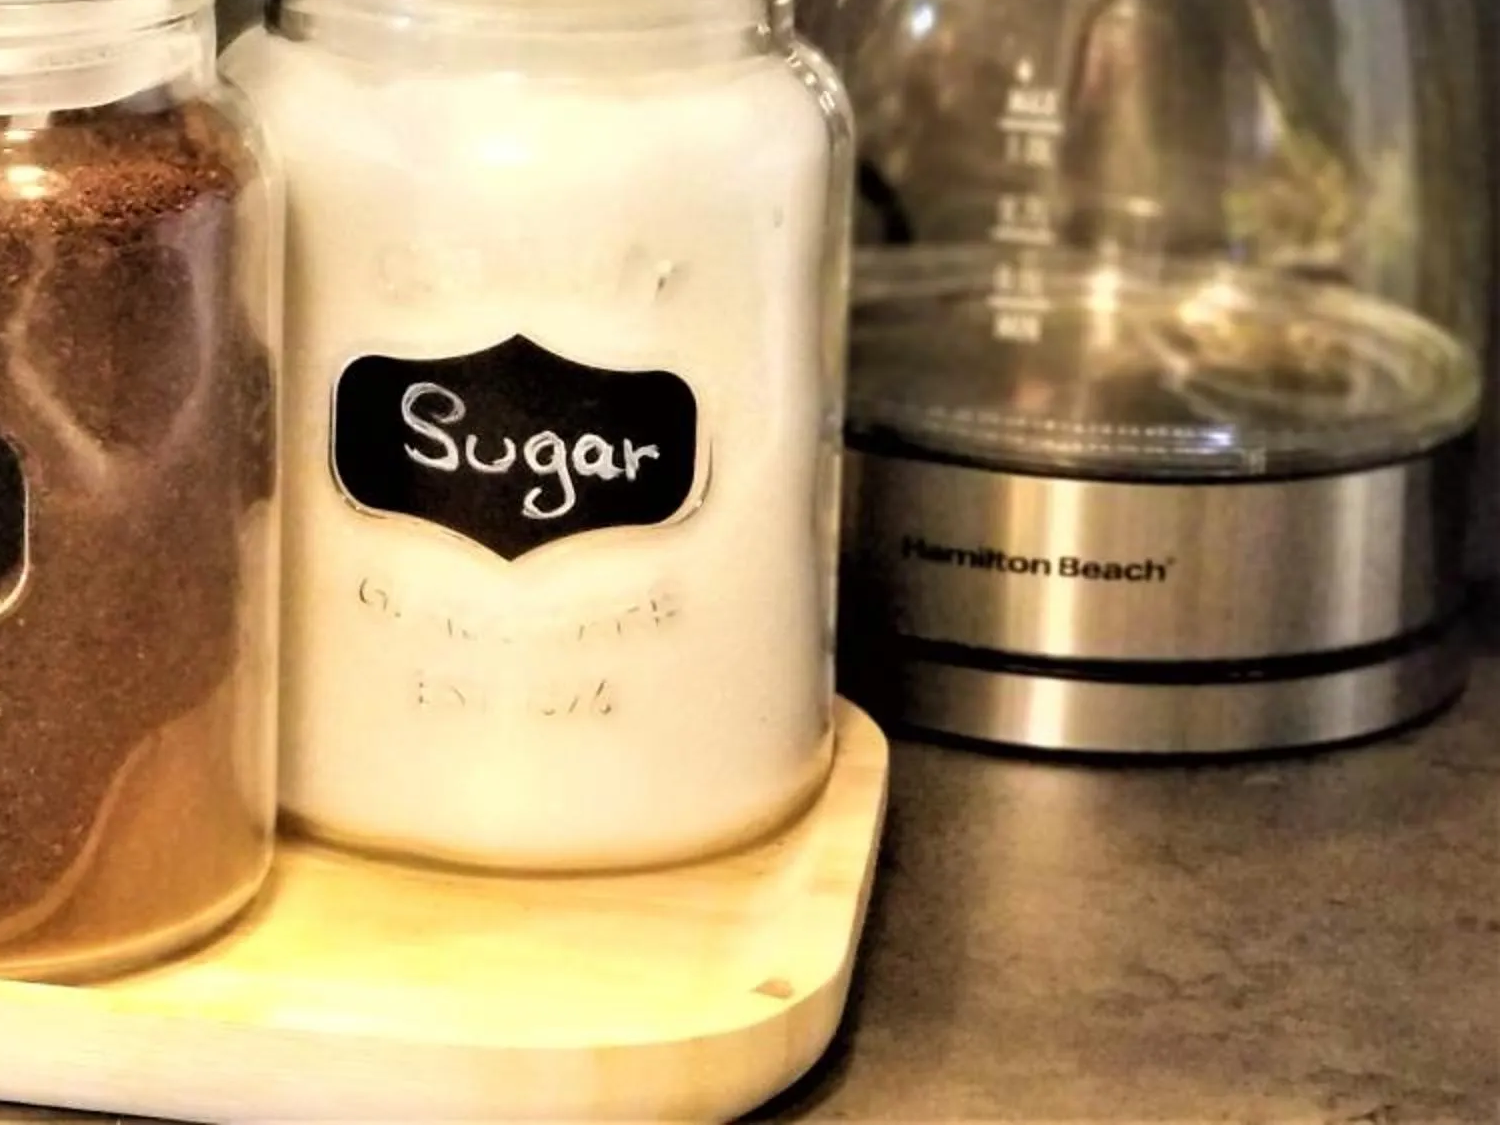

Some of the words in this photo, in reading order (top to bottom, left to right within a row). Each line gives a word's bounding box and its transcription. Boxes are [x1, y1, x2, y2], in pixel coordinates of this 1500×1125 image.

[401, 381, 660, 519] Sugar
[901, 534, 1050, 576] Hamilton
[1058, 556, 1168, 582] Beach
